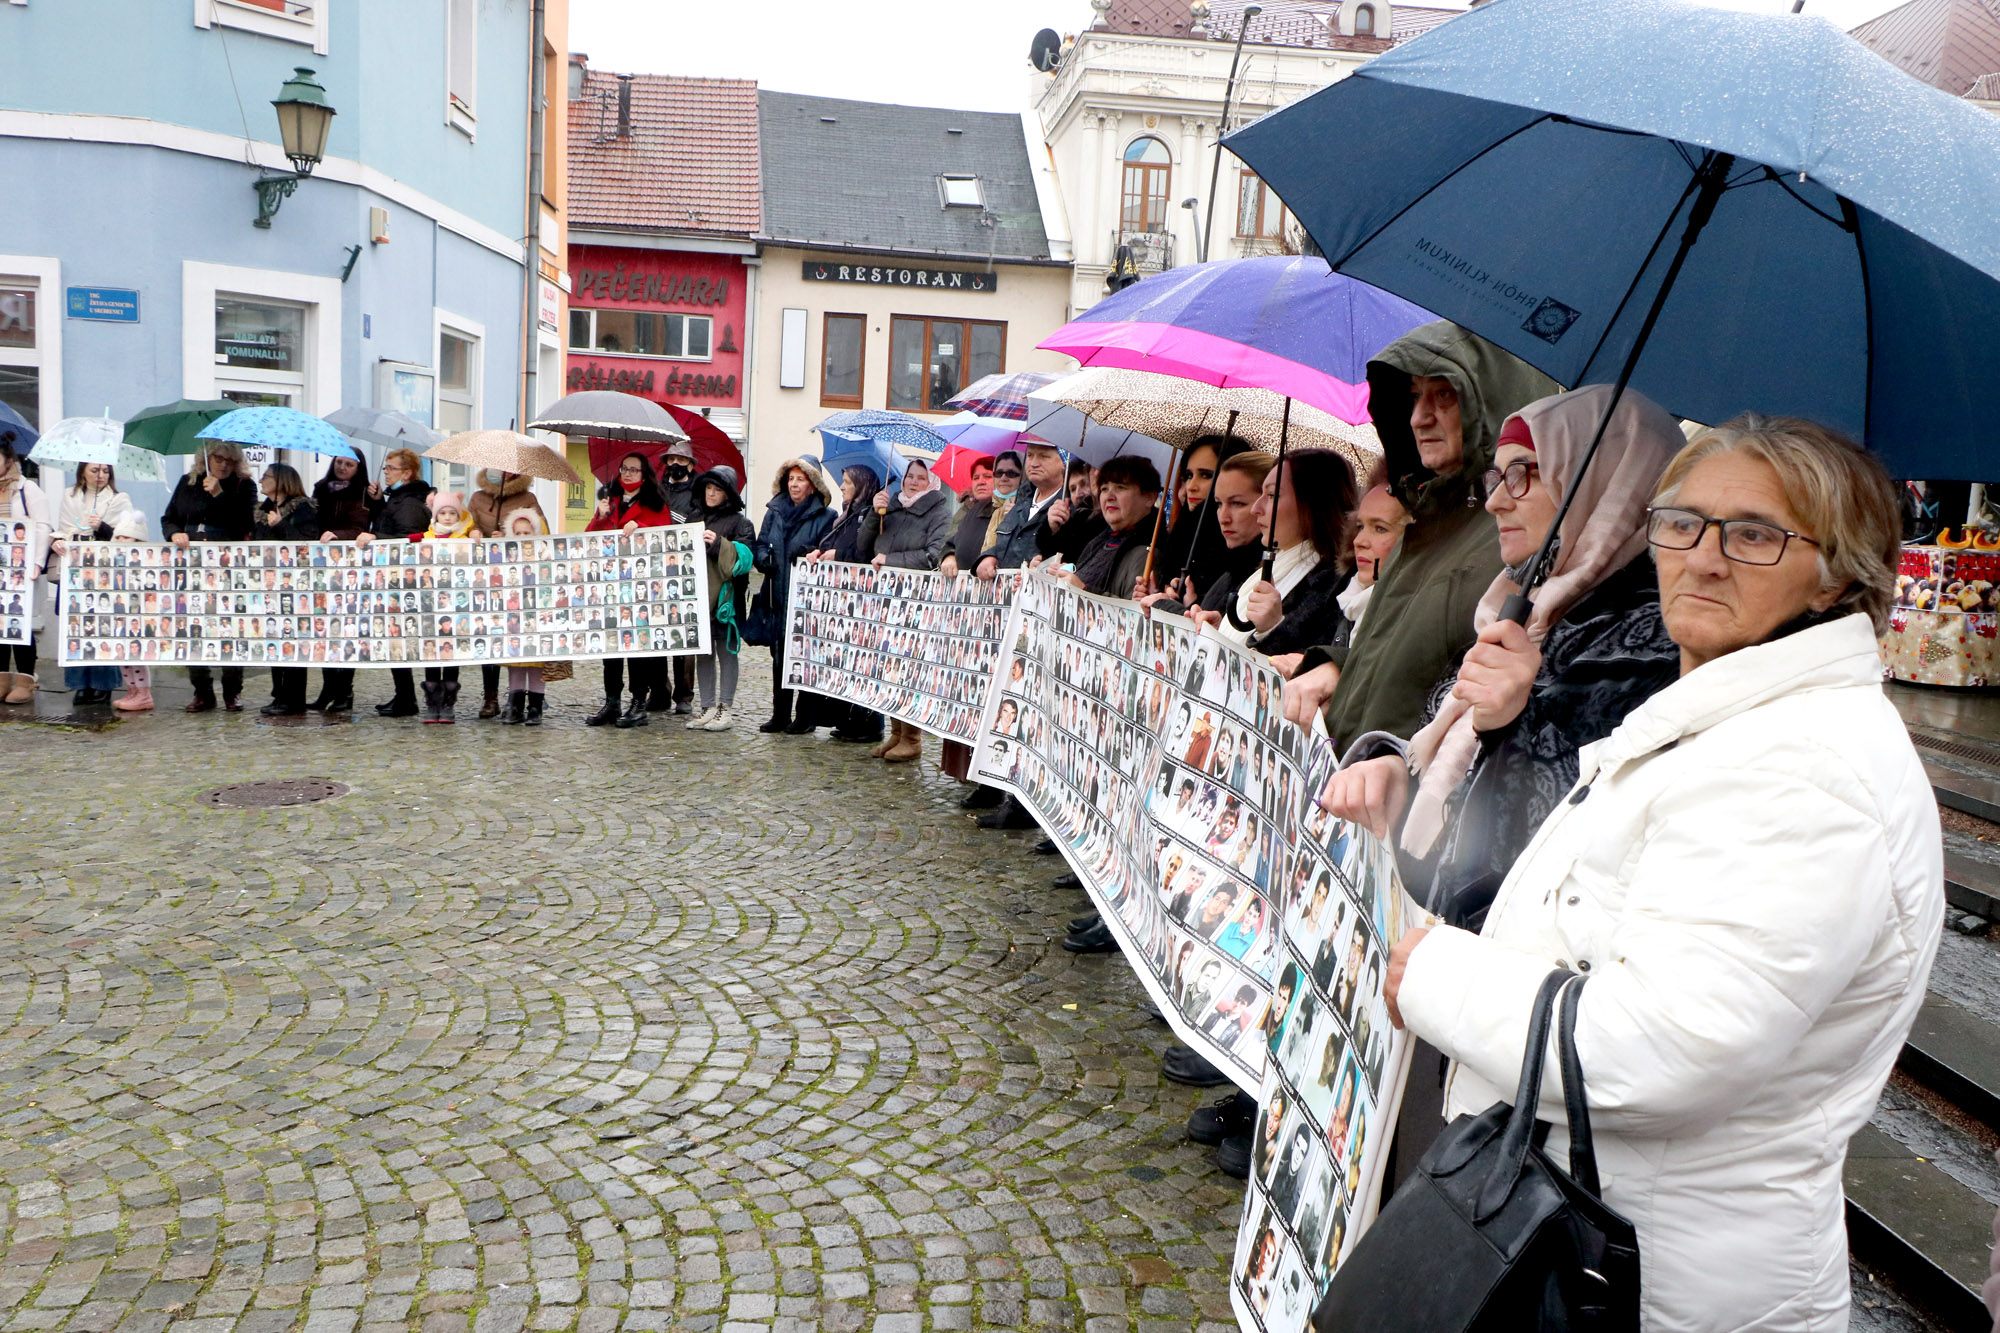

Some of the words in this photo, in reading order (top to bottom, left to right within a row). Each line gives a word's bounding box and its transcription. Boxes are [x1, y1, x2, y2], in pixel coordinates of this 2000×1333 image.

[576, 264, 729, 306] PEČENJARA
[838, 265, 962, 288] RESTORAN
[233, 332, 277, 345] NAPLATA
[224, 346, 288, 360] KOMUNALIJA
[665, 365, 736, 398] ČESMA
